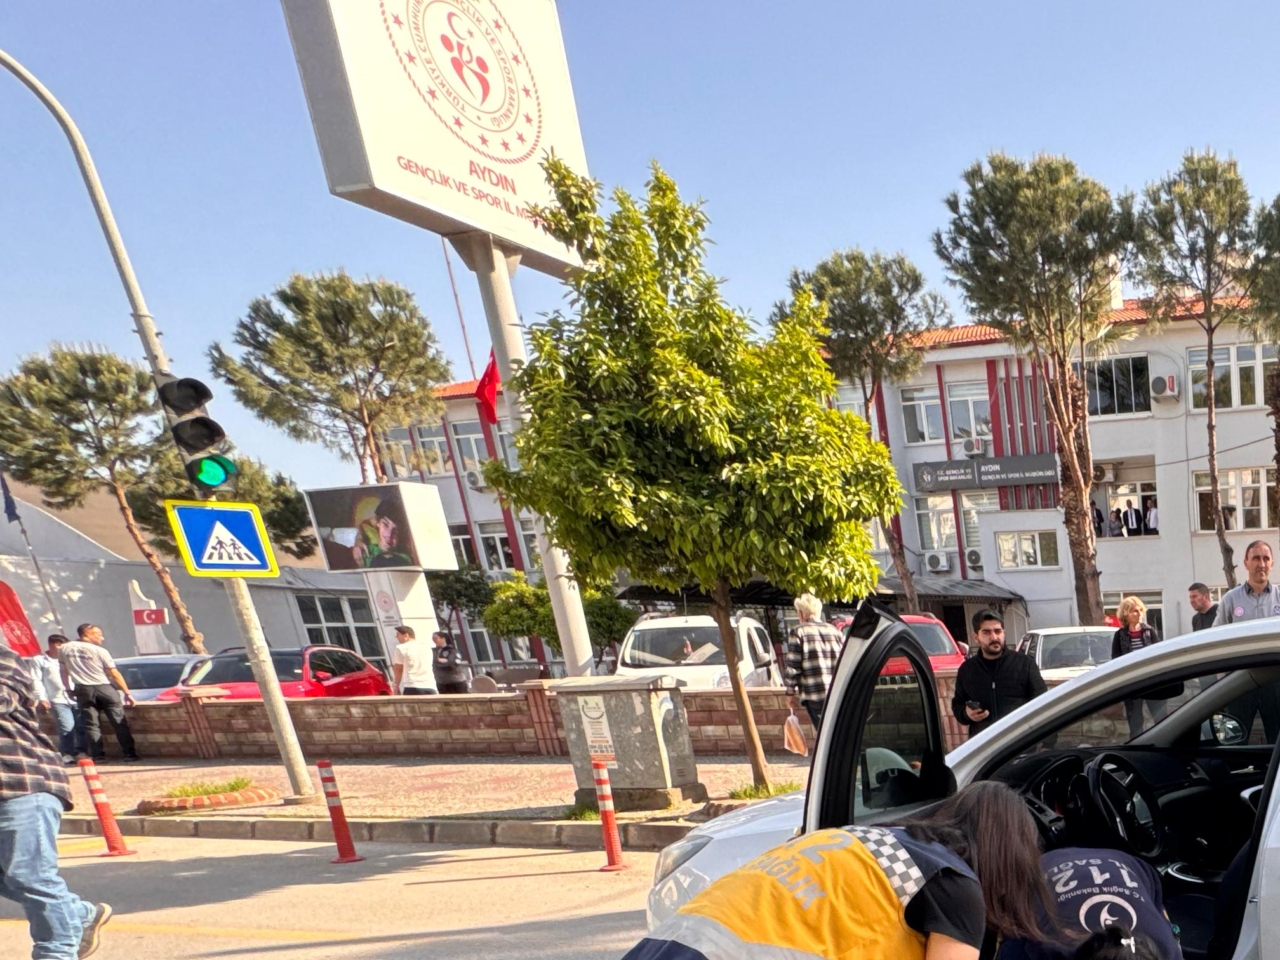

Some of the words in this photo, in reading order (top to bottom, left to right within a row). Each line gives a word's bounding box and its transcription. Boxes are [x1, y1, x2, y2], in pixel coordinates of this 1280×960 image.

[496, 48, 514, 85] SPOR
[396, 155, 453, 190] GENÇLİK
[452, 178, 471, 197] VE
[471, 187, 503, 211] SPOR
[468, 160, 518, 196] AYDIN
[981, 463, 1000, 472] AYDIN
[1051, 866, 1138, 894] 112
